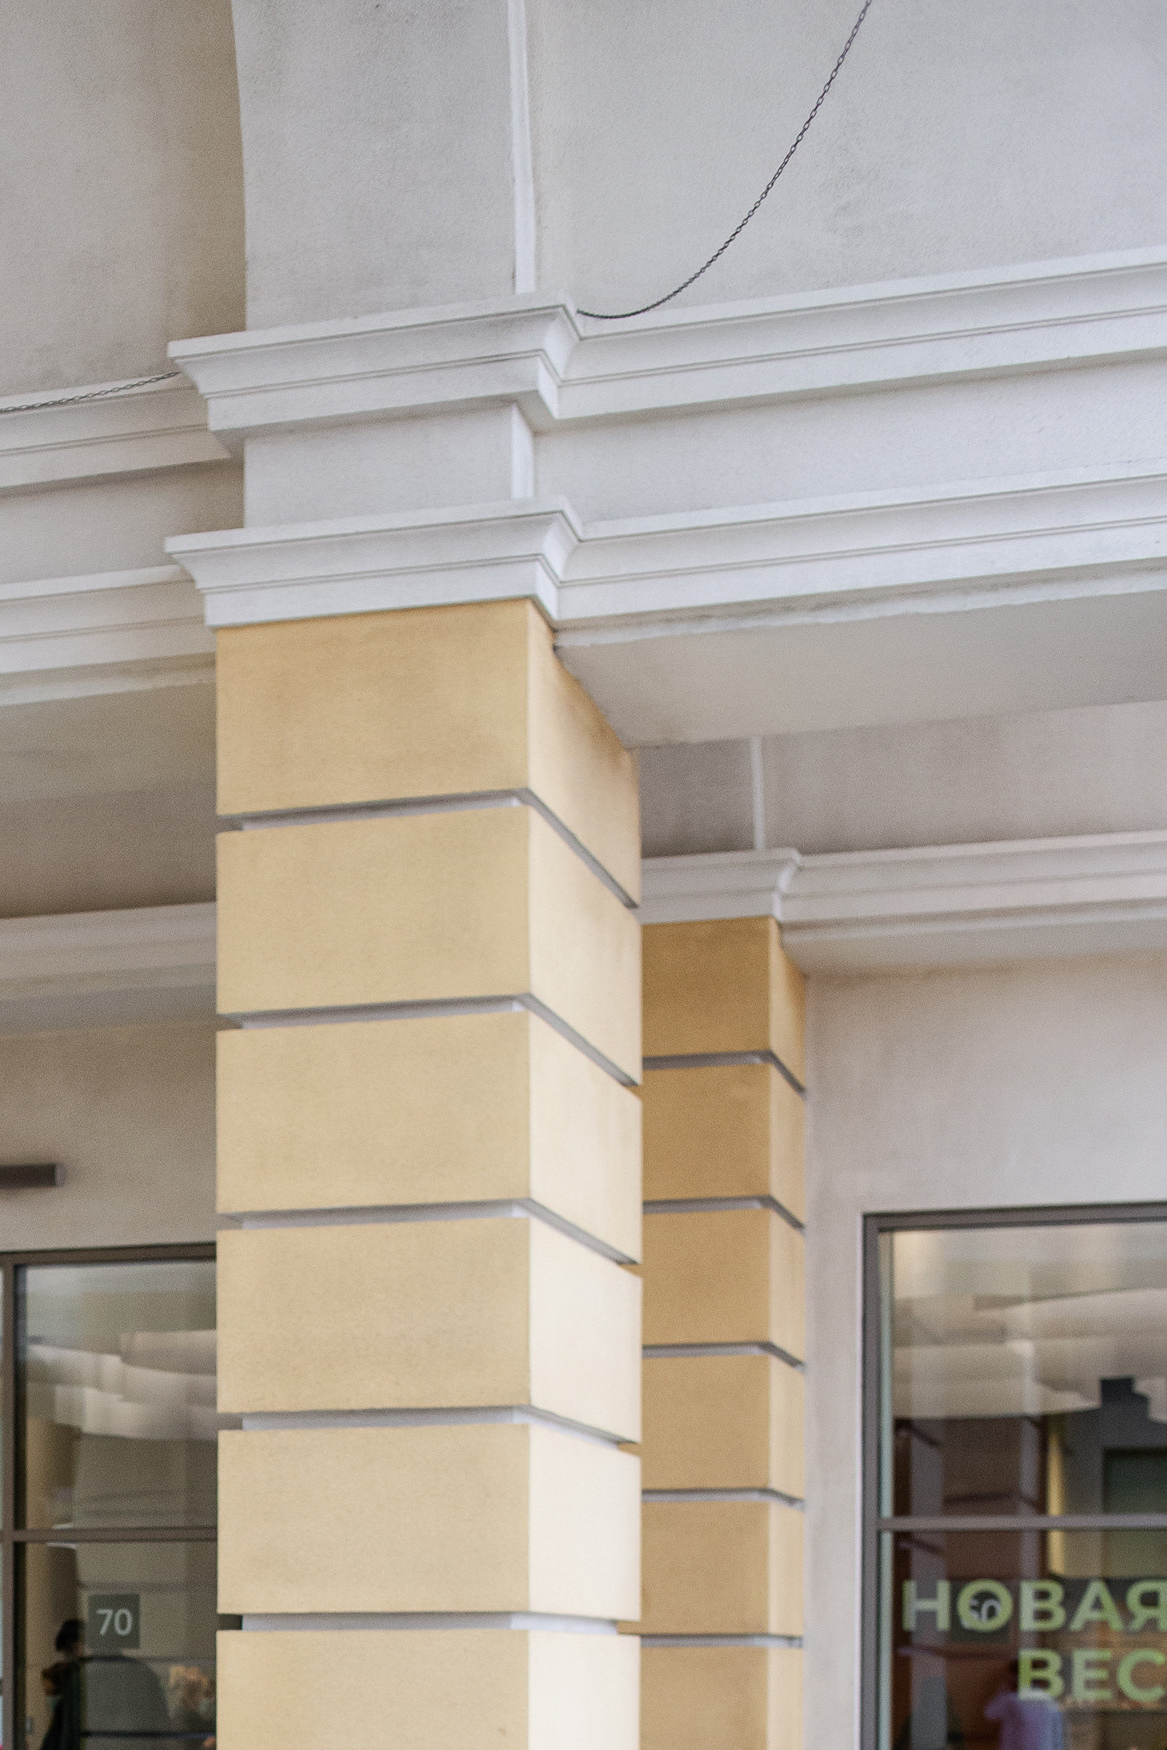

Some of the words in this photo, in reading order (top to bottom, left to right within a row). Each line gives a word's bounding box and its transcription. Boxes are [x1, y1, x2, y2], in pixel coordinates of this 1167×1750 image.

[96, 1608, 133, 1636] 70
[902, 1579, 1167, 1632] НОВАЯ
[1018, 1648, 1166, 1702] ВЕС
